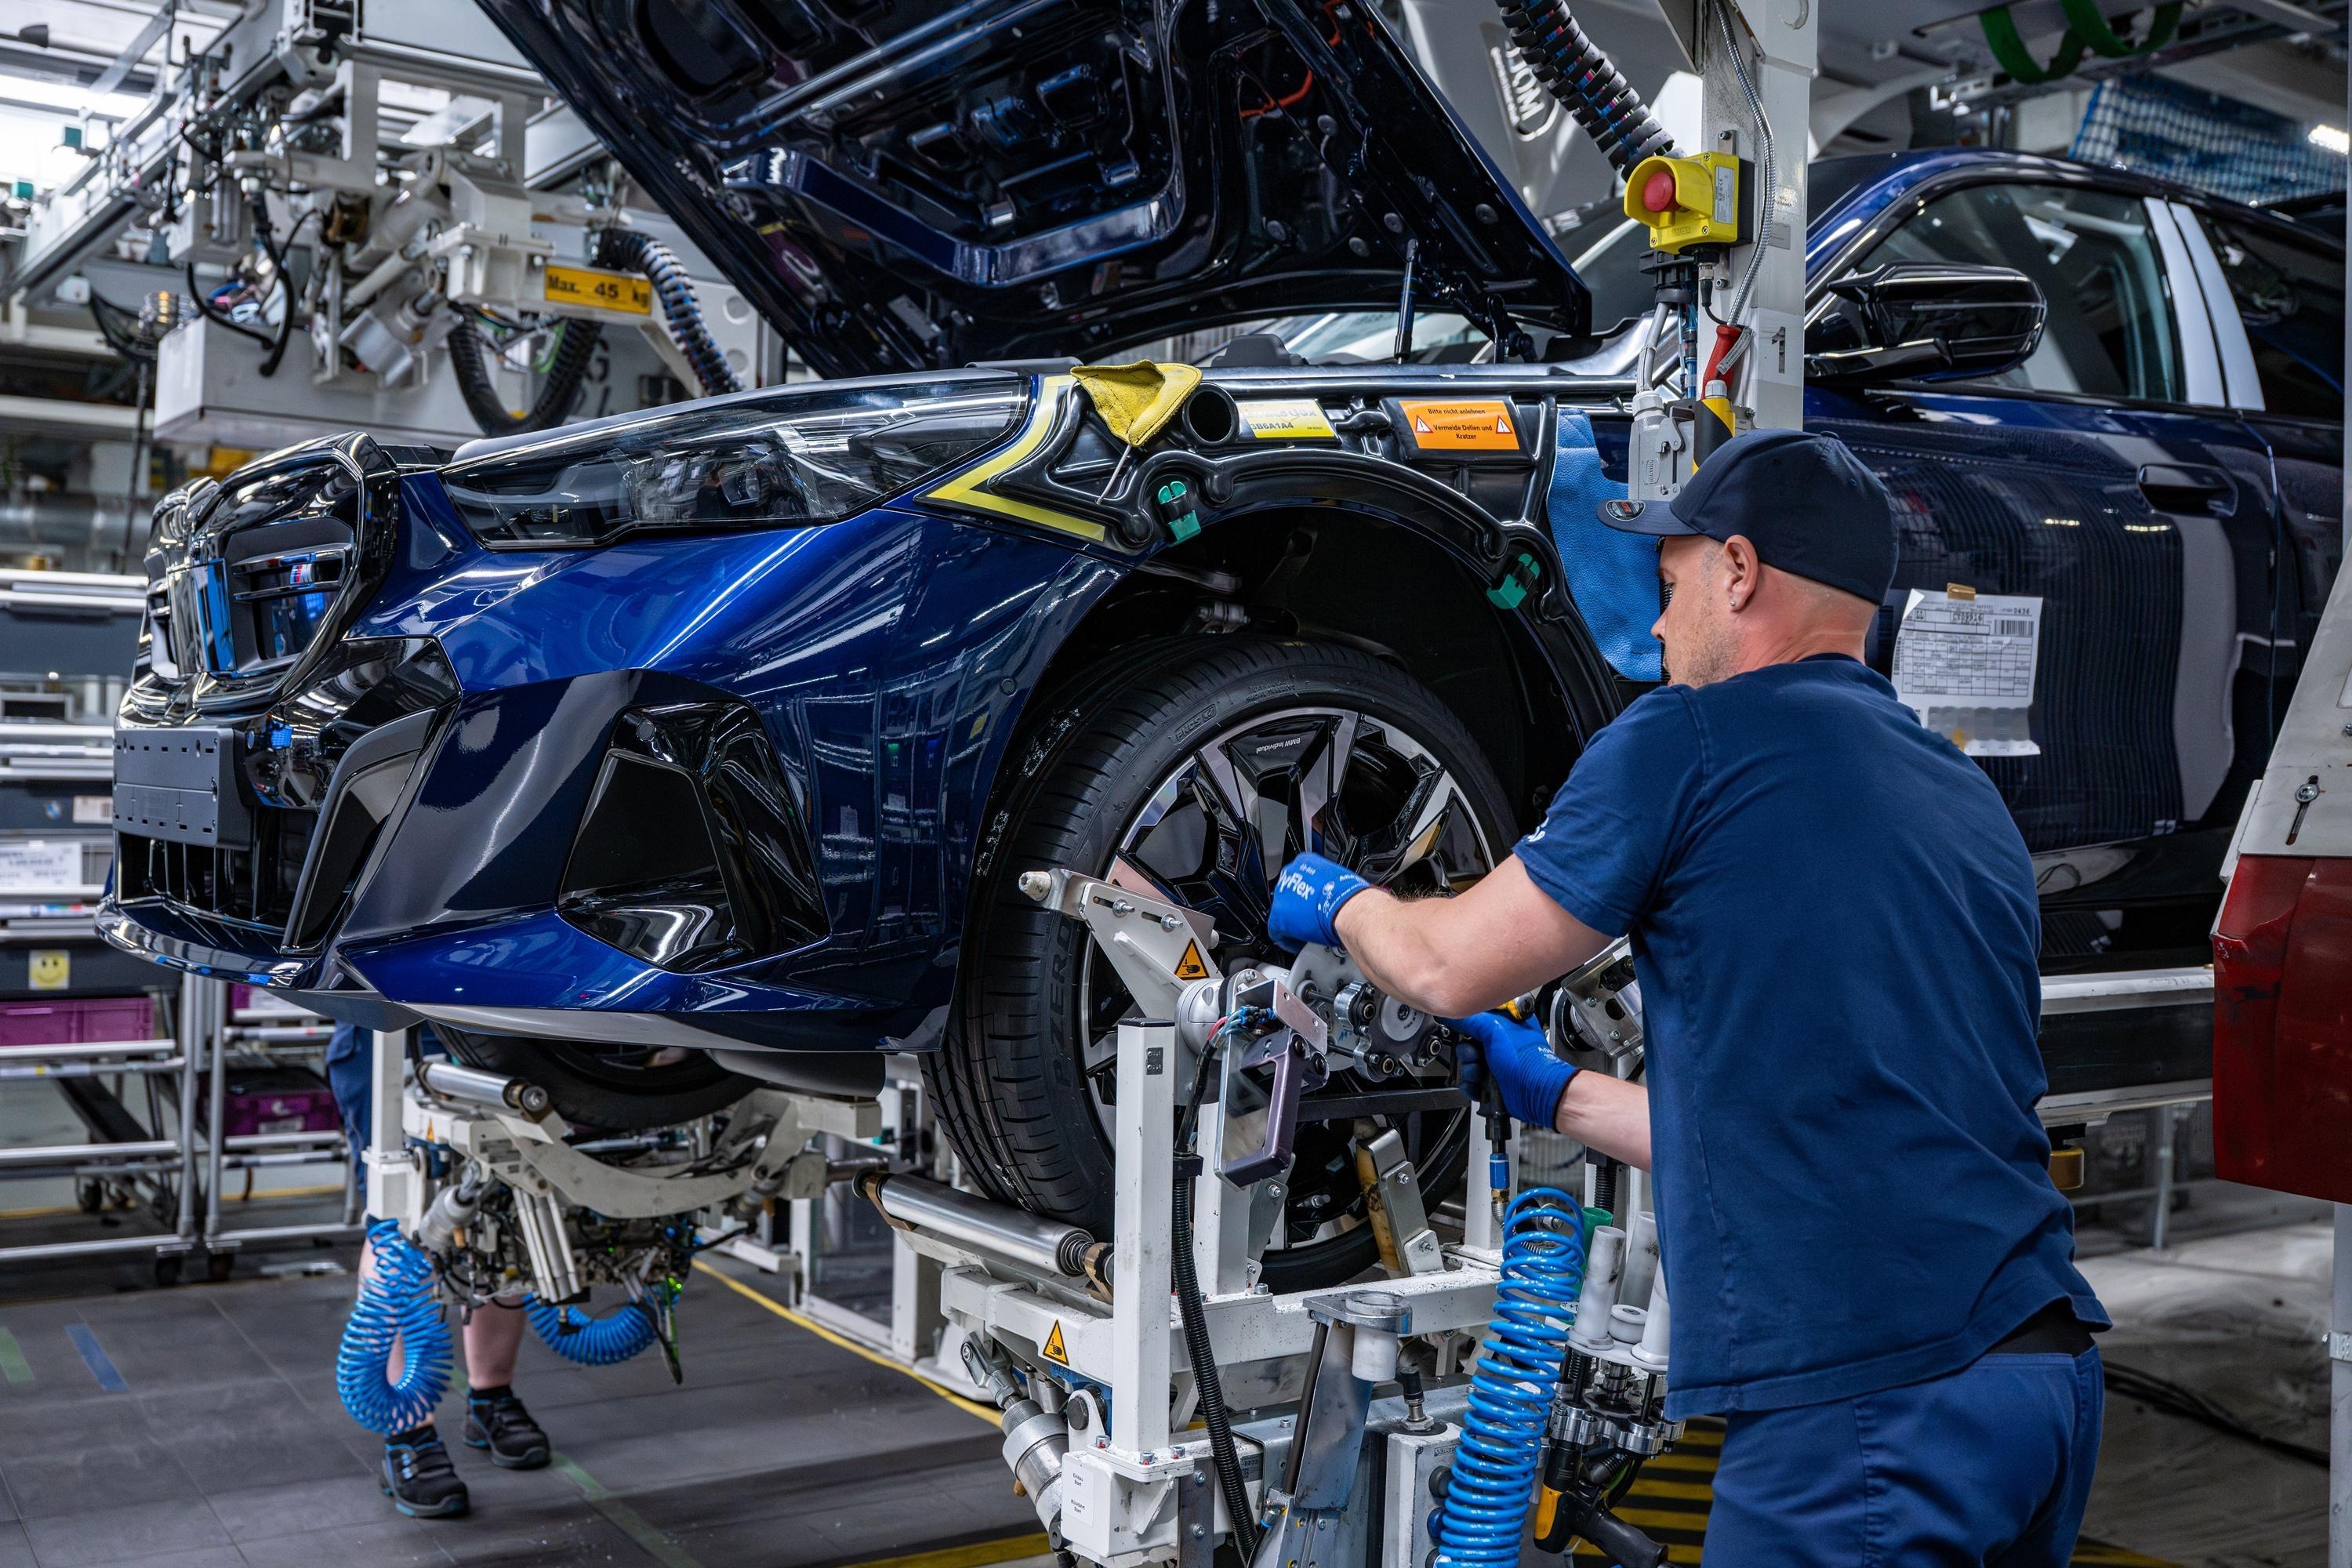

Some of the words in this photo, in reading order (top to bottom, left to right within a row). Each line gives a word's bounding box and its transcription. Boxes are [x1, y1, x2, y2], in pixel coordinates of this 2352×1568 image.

[549, 274, 581, 294] Max.
[594, 282, 619, 299] 45
[632, 287, 648, 308] kg
[1771, 326, 1786, 374] 1
[1256, 741, 1284, 754] Individual
[1285, 737, 1301, 747] BMW
